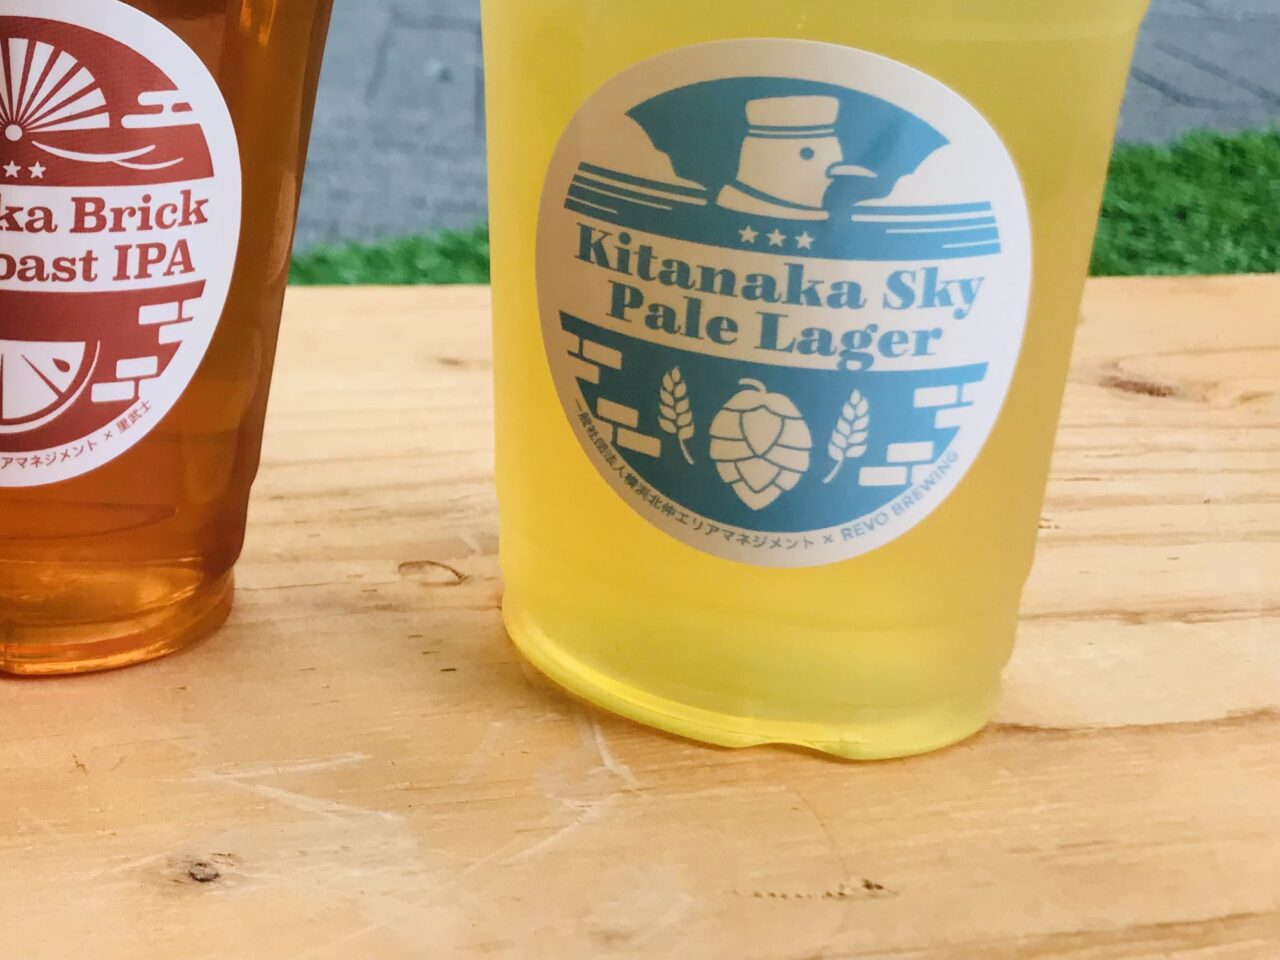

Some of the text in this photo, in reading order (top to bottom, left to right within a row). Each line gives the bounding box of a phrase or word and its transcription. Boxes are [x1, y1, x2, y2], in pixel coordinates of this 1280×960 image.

[69, 189, 209, 235] Brick
[112, 238, 196, 282] IPA
[573, 221, 985, 319] Kitanaka Sky
[606, 280, 943, 373] Pale Lager
[840, 512, 889, 541] REVO
[890, 449, 959, 516] BREWING
